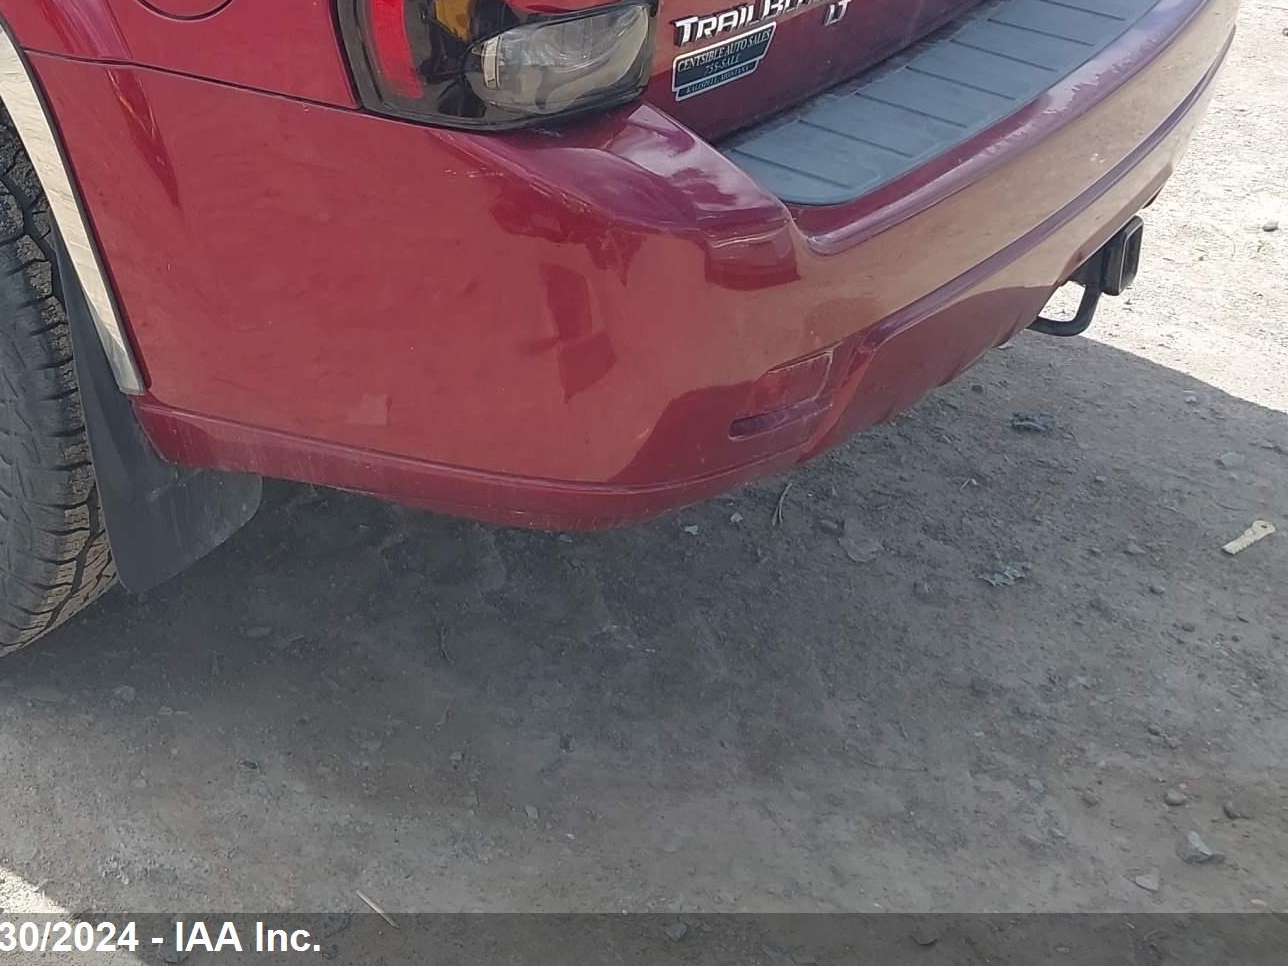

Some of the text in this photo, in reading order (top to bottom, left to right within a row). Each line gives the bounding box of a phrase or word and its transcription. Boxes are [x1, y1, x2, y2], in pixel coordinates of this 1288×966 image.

[677, 29, 772, 72] CENTSIBLE AUTO SALES
